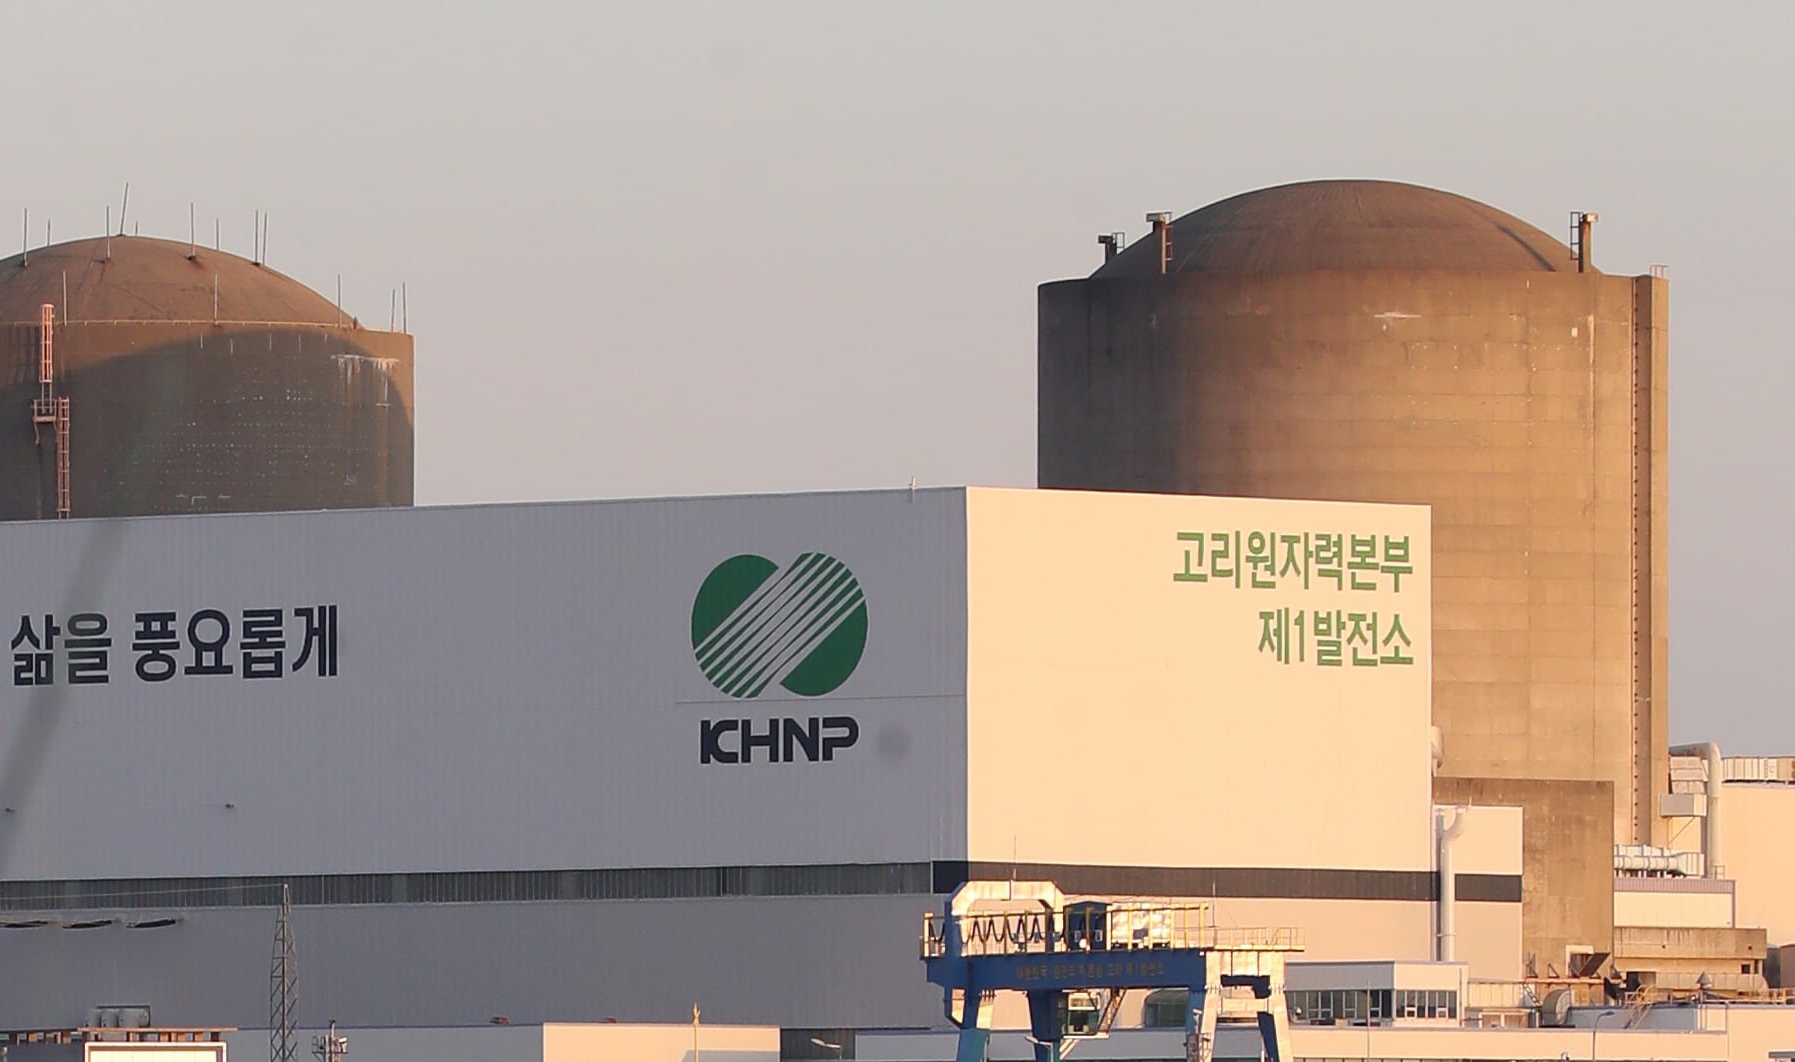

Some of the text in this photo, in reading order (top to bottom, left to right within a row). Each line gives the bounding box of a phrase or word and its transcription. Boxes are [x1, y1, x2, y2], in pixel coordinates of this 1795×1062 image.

[1173, 530, 1415, 592] 고리원자력본부
[9, 613, 113, 686] 삶을
[130, 605, 340, 682] 풍요롭게
[1258, 607, 1416, 668] 제1발전소
